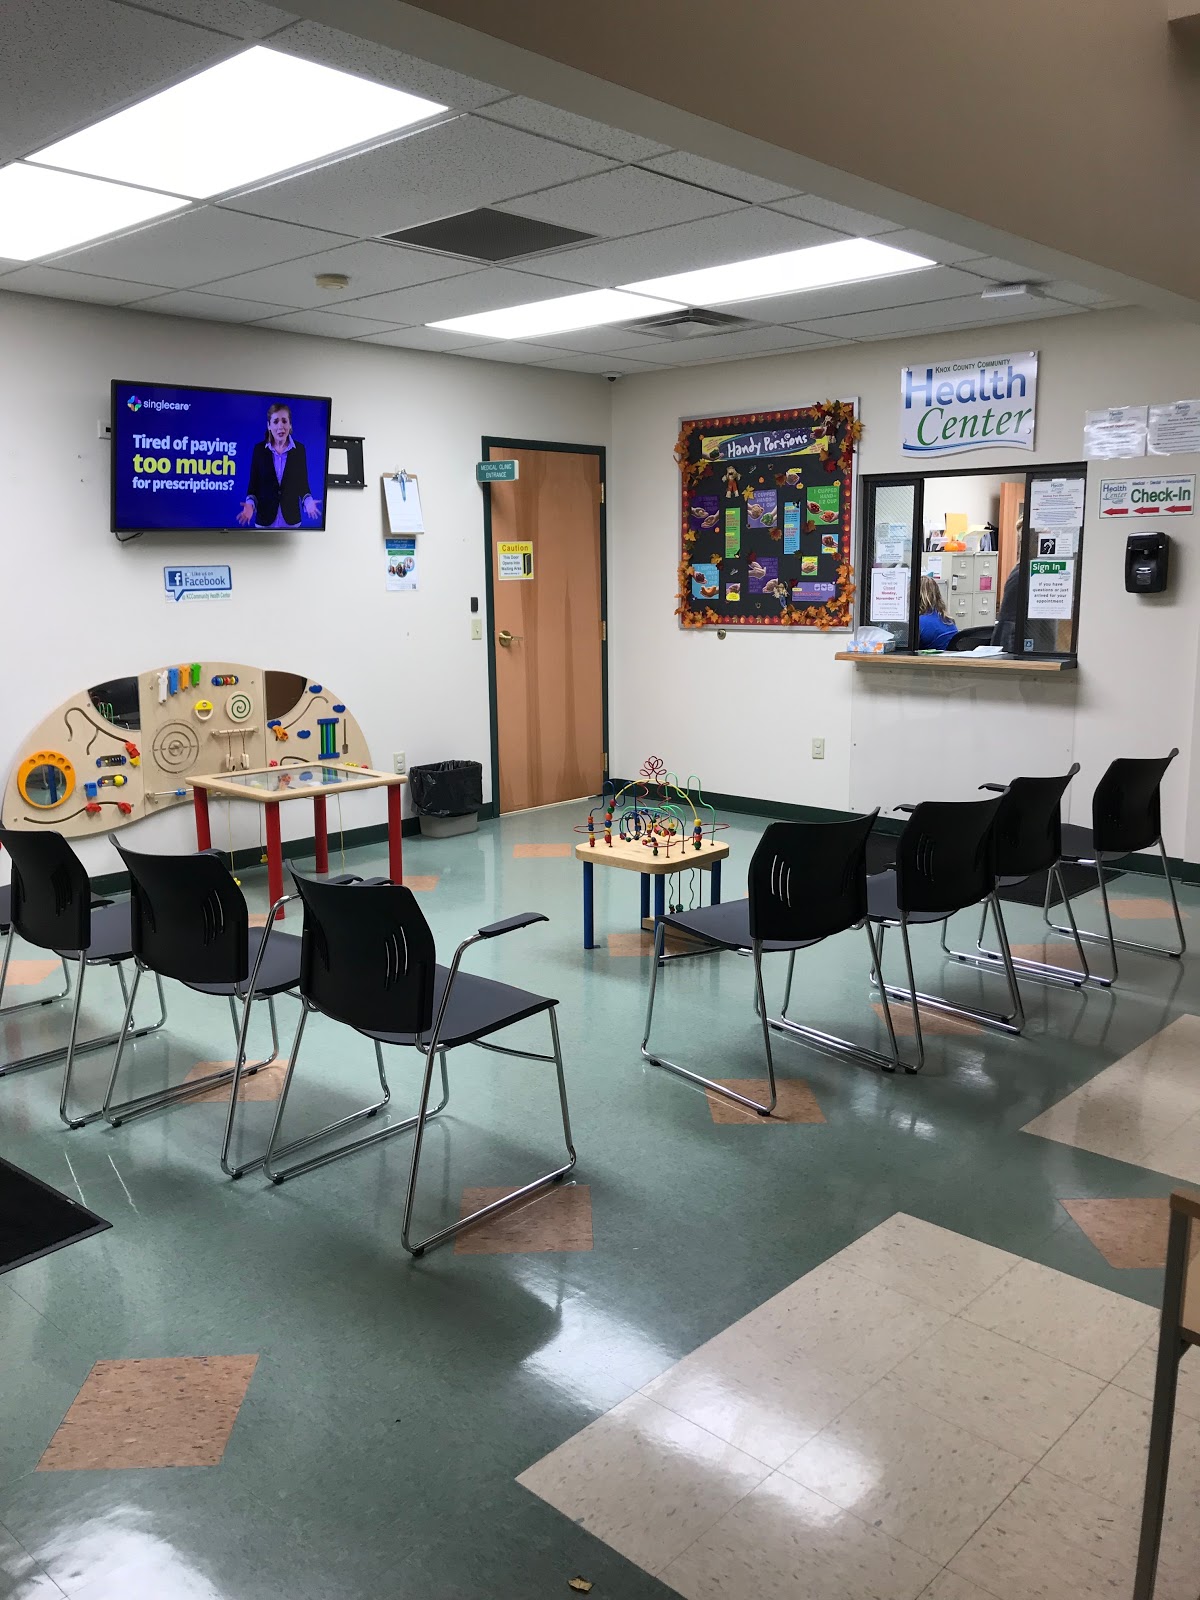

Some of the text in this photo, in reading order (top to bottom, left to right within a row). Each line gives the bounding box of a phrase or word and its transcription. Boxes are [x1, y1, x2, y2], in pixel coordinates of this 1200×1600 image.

[935, 358, 1011, 374] KNOX COUNTY COMMUNITY
[905, 366, 1026, 409] Health
[143, 399, 189, 412] singlecare
[917, 407, 1032, 446] Center
[132, 434, 237, 456] Tired of paying
[728, 437, 760, 458] Handy
[764, 433, 808, 452] Portions
[133, 454, 236, 476] too much
[132, 476, 234, 493] for prescriptions?
[1103, 484, 1126, 492] Health
[1105, 491, 1127, 499] Center
[1130, 486, 1191, 503] Check-In
[502, 544, 528, 552] Caution
[1032, 562, 1050, 574] Sign
[184, 576, 226, 586] Facebook
